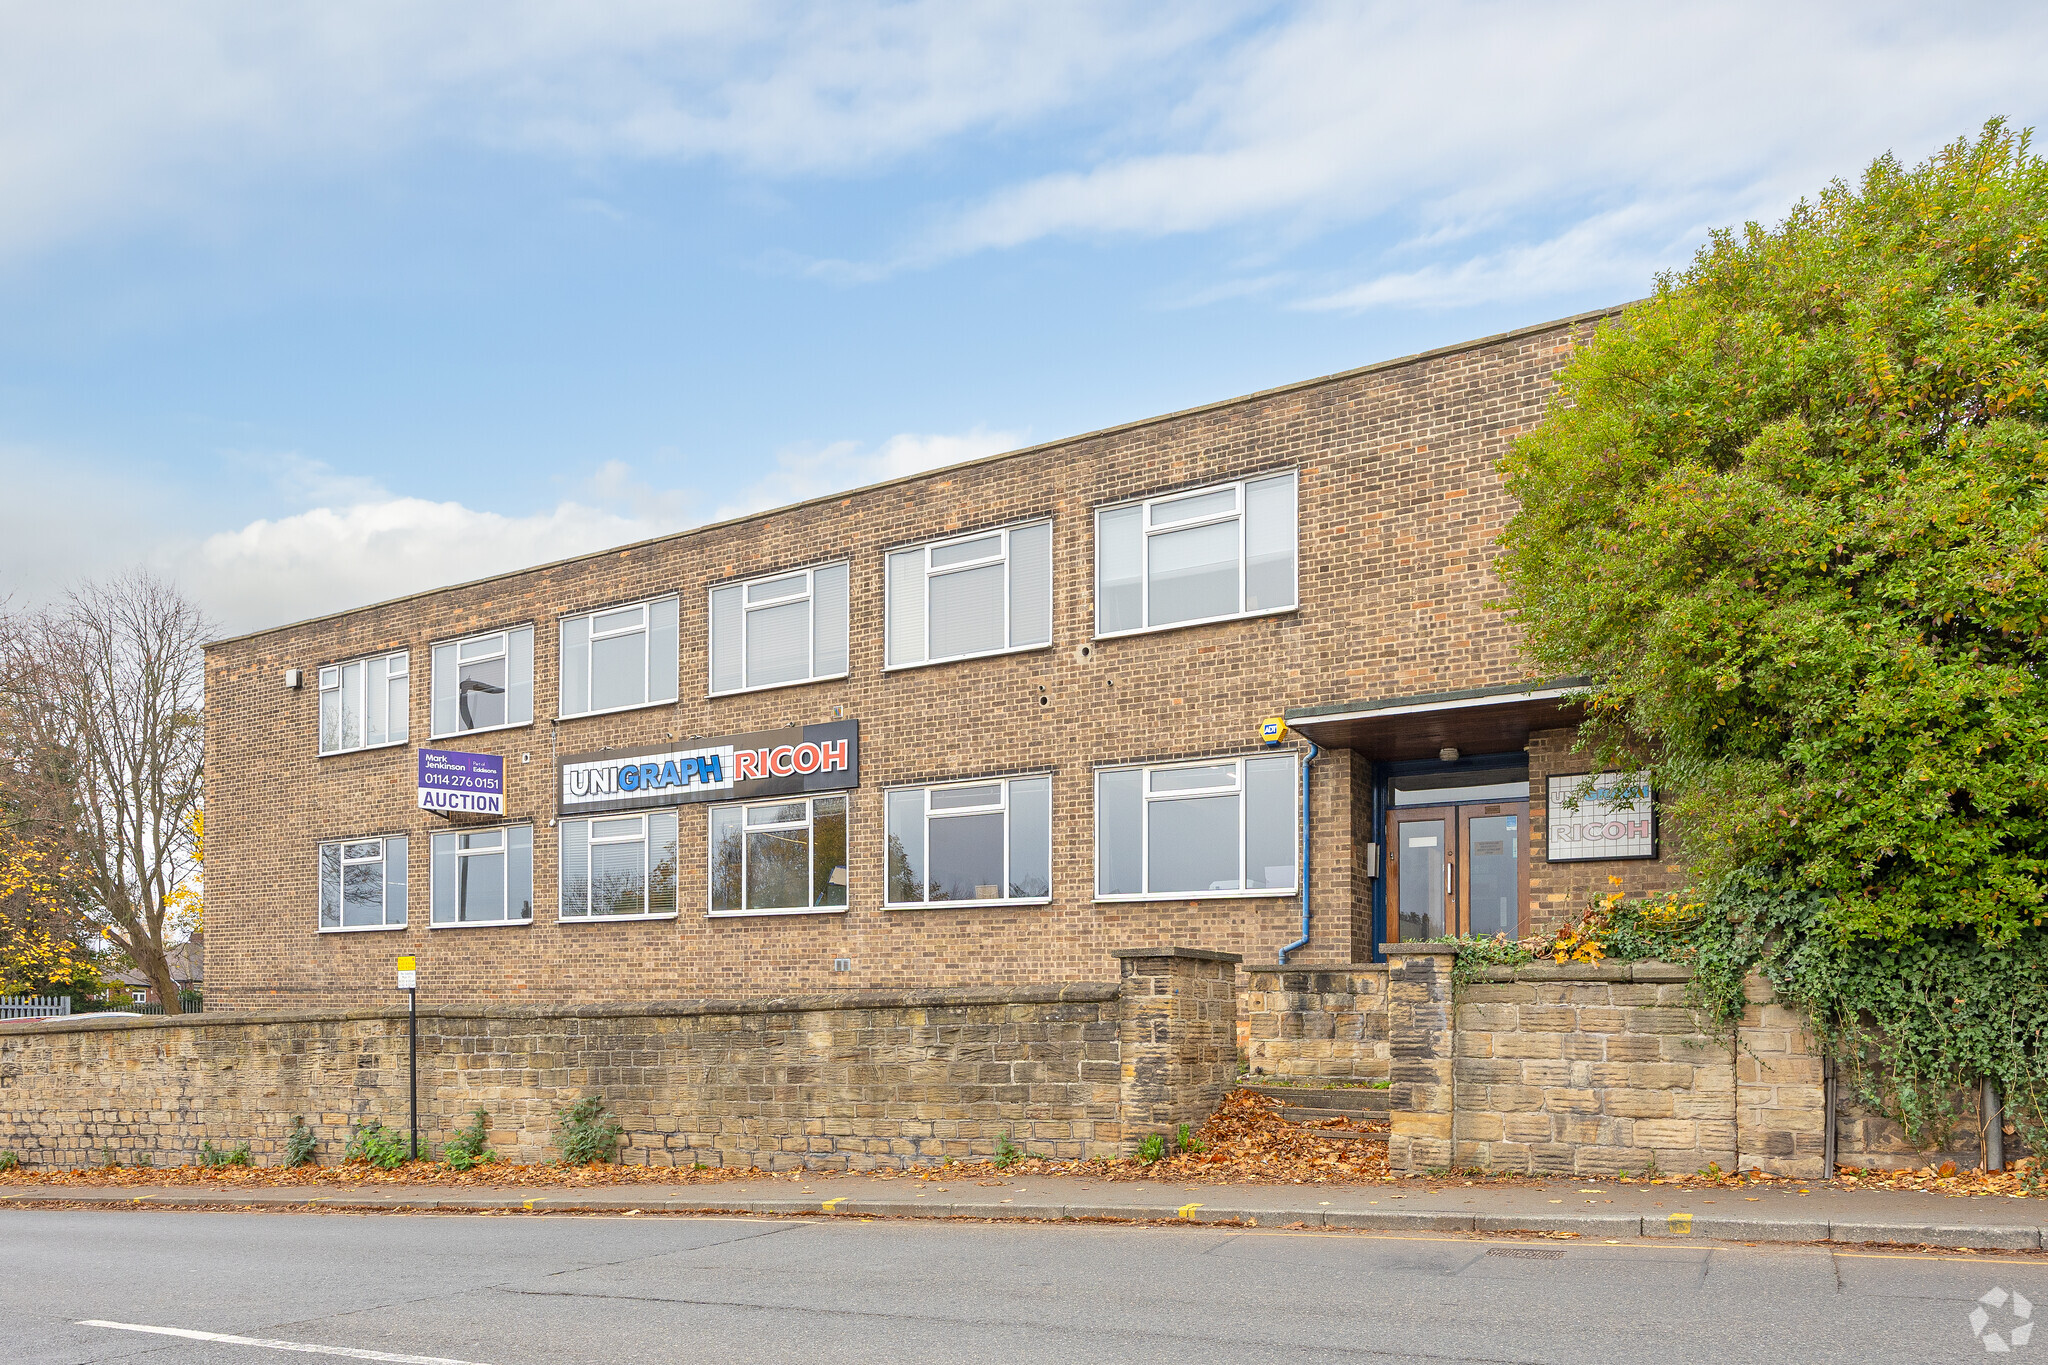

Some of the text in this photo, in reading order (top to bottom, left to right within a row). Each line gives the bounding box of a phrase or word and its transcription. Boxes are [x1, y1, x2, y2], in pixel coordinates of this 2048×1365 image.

[1264, 725, 1277, 734] ADT
[425, 754, 448, 763] Mark
[425, 761, 466, 772] Jenkinson
[569, 738, 849, 796] UNIGRAPH RICOH
[425, 773, 499, 790] 0114 276 0151
[423, 791, 500, 812] AUCTION
[1551, 819, 1650, 844] RICOH
